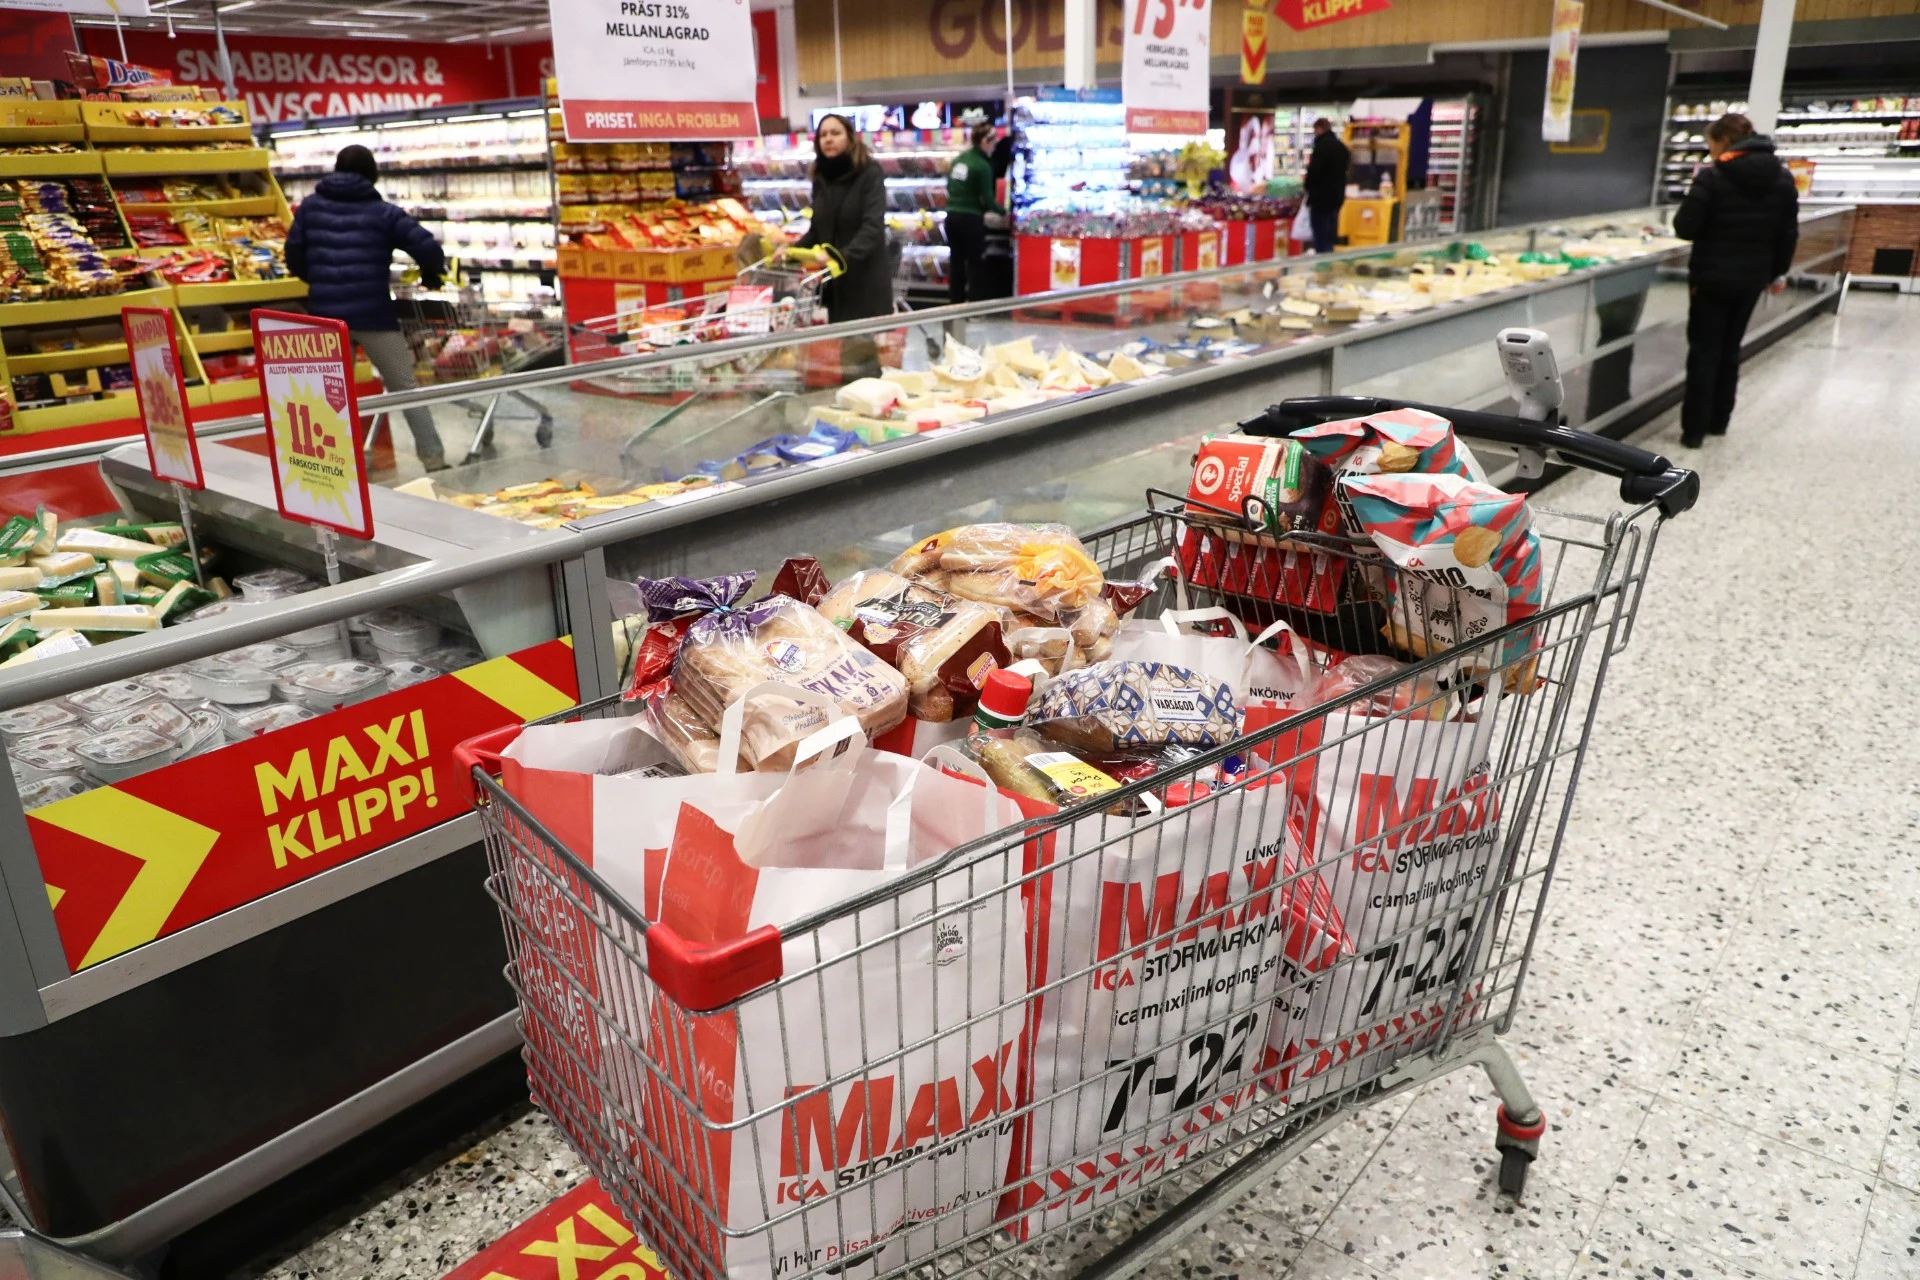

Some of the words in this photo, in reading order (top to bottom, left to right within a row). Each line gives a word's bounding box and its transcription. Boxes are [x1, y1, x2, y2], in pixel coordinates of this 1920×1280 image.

[622, 0, 662, 18] PRÄST
[665, 5, 690, 20] 31%
[606, 22, 710, 40] MELLANLAGRAD
[176, 49, 418, 86] SNABBKASSOR
[423, 57, 444, 86] &
[585, 112, 638, 129] PRISET.
[639, 113, 676, 129] INGA
[677, 113, 740, 129] PROBLEM
[269, 365, 286, 375] ALLTID
[288, 365, 305, 375] MINST
[319, 364, 342, 374] RABATT
[289, 456, 320, 472] FÄRSKOST
[321, 463, 345, 478] VITLÖK
[1228, 456, 1250, 502] Special
[1154, 699, 1195, 711] VARSÅGOD
[254, 708, 431, 817] MAXI
[267, 766, 438, 870] KLIPP!
[1246, 837, 1285, 862] LINKÖ
[1352, 852, 1390, 873] ICA
[1093, 965, 1135, 992] ICA
[1143, 914, 1283, 982] STORMARKNA
[1360, 916, 1473, 1016] 7-22
[1103, 1012, 1258, 1132] 7-22
[777, 1178, 829, 1205] ICA
[794, 1249, 821, 1268] har
